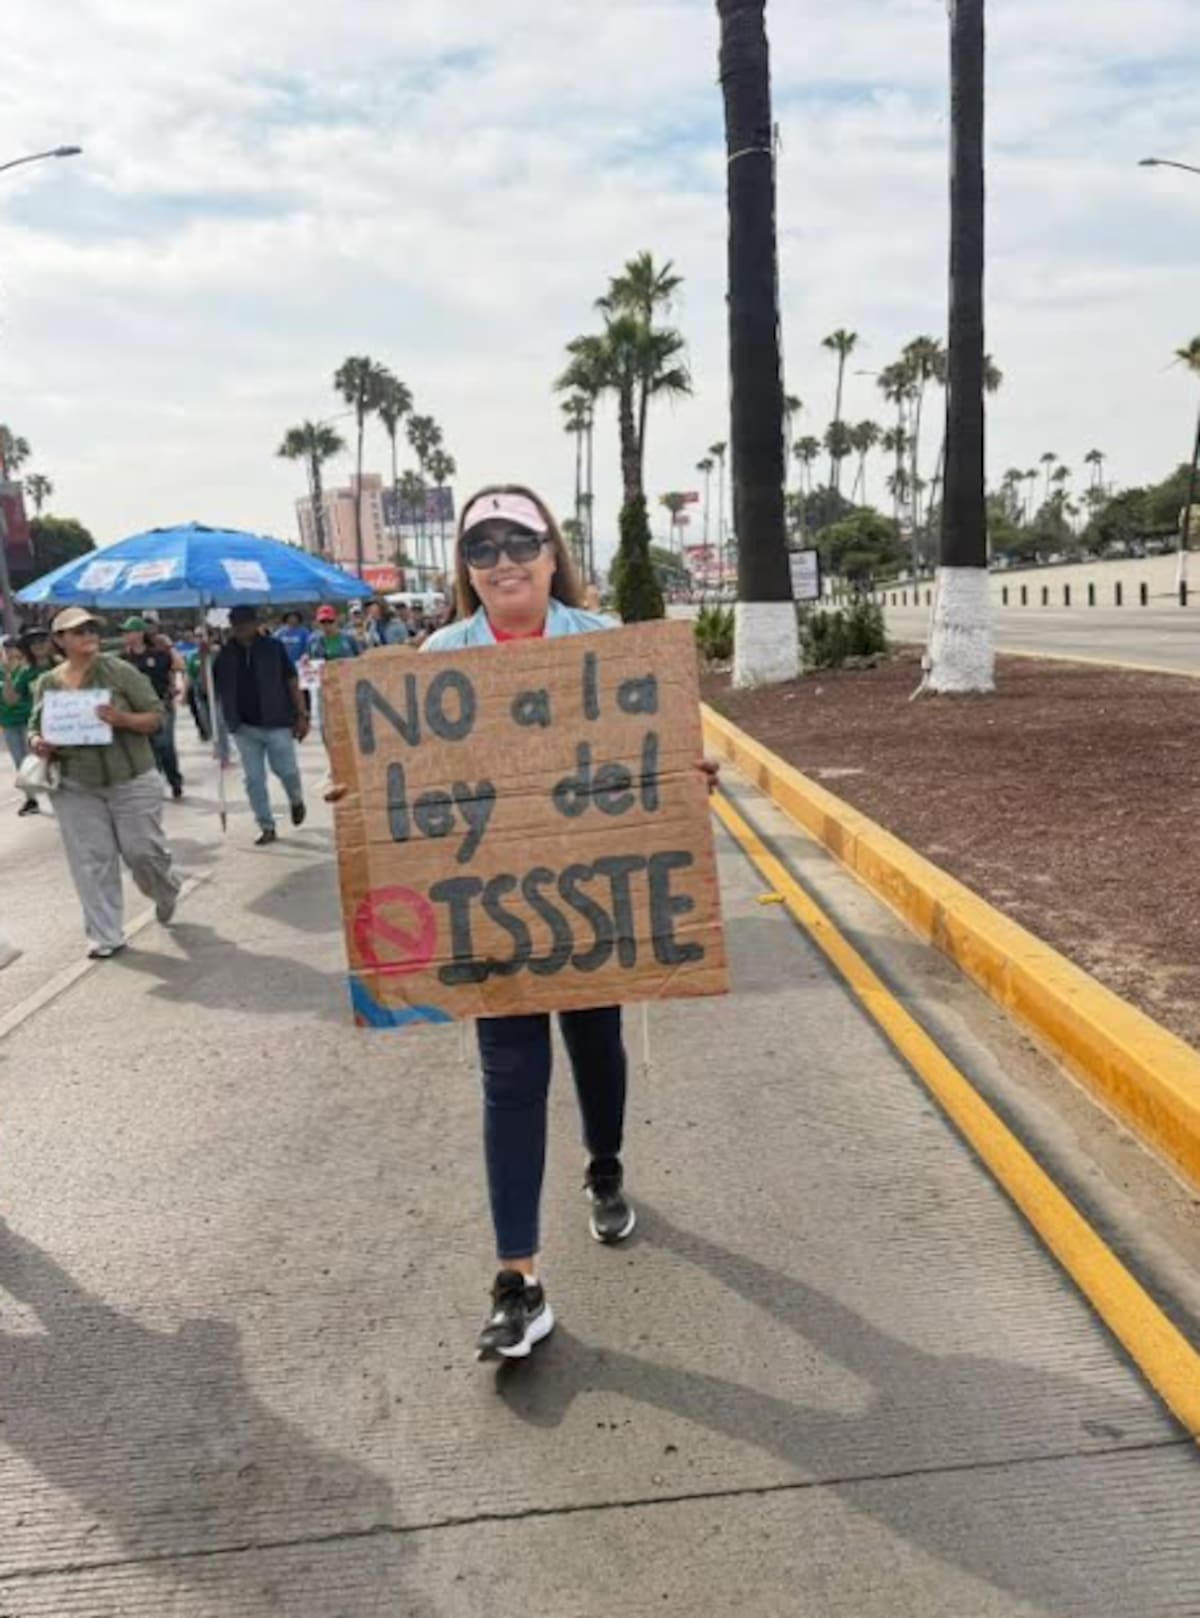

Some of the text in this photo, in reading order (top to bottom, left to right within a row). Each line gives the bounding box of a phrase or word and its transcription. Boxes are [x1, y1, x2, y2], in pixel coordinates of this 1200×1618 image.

[355, 651, 659, 755] NO a la
[386, 731, 660, 864] ley del
[429, 850, 704, 986] ISSSTE
